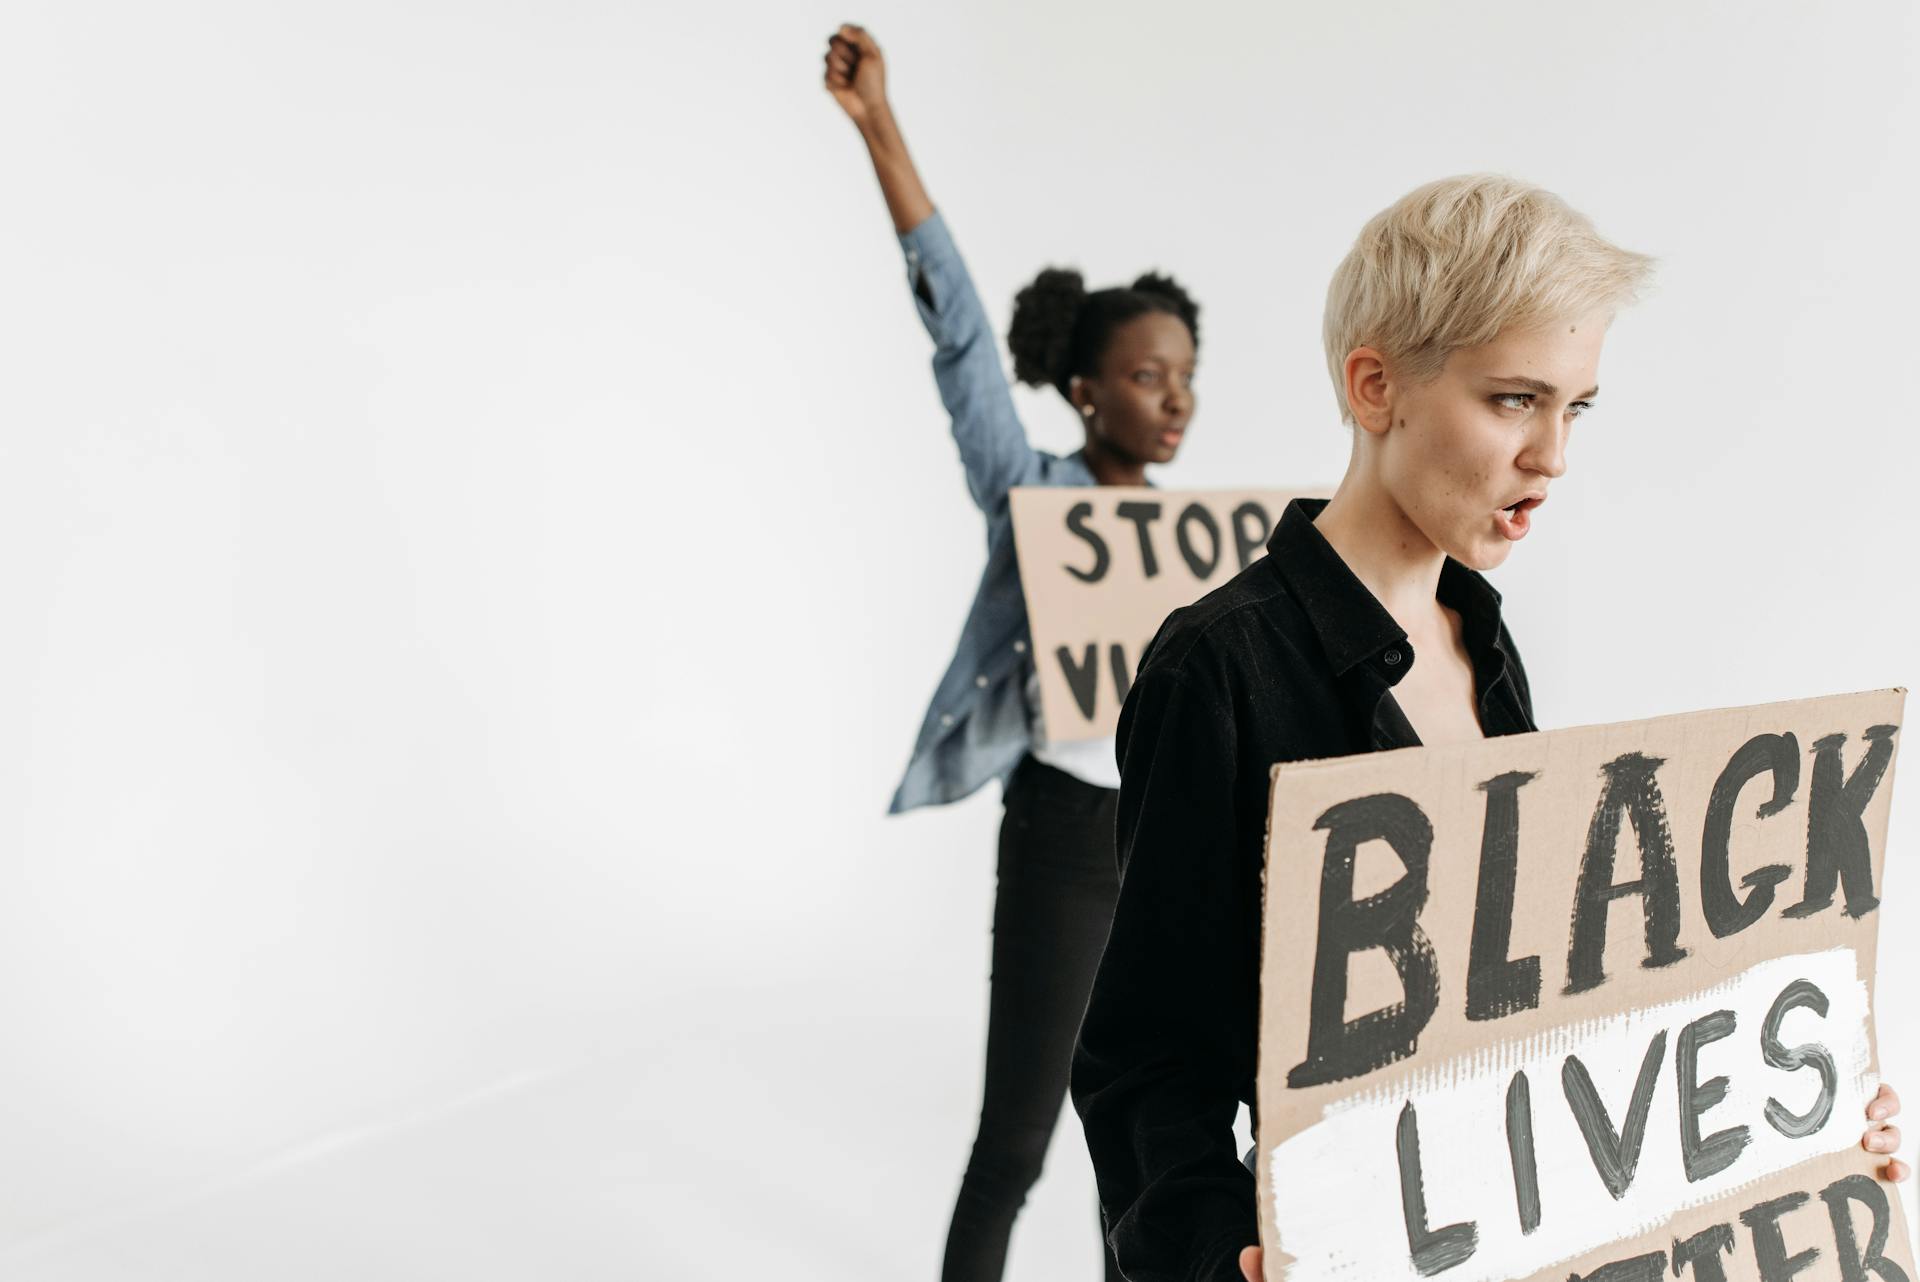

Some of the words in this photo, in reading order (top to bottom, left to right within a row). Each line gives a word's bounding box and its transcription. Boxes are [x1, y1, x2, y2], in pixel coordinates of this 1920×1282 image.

[1062, 501, 1272, 583] STOP
[1287, 724, 1899, 1089] BLACK
[1396, 978, 1837, 1277] LIVES
